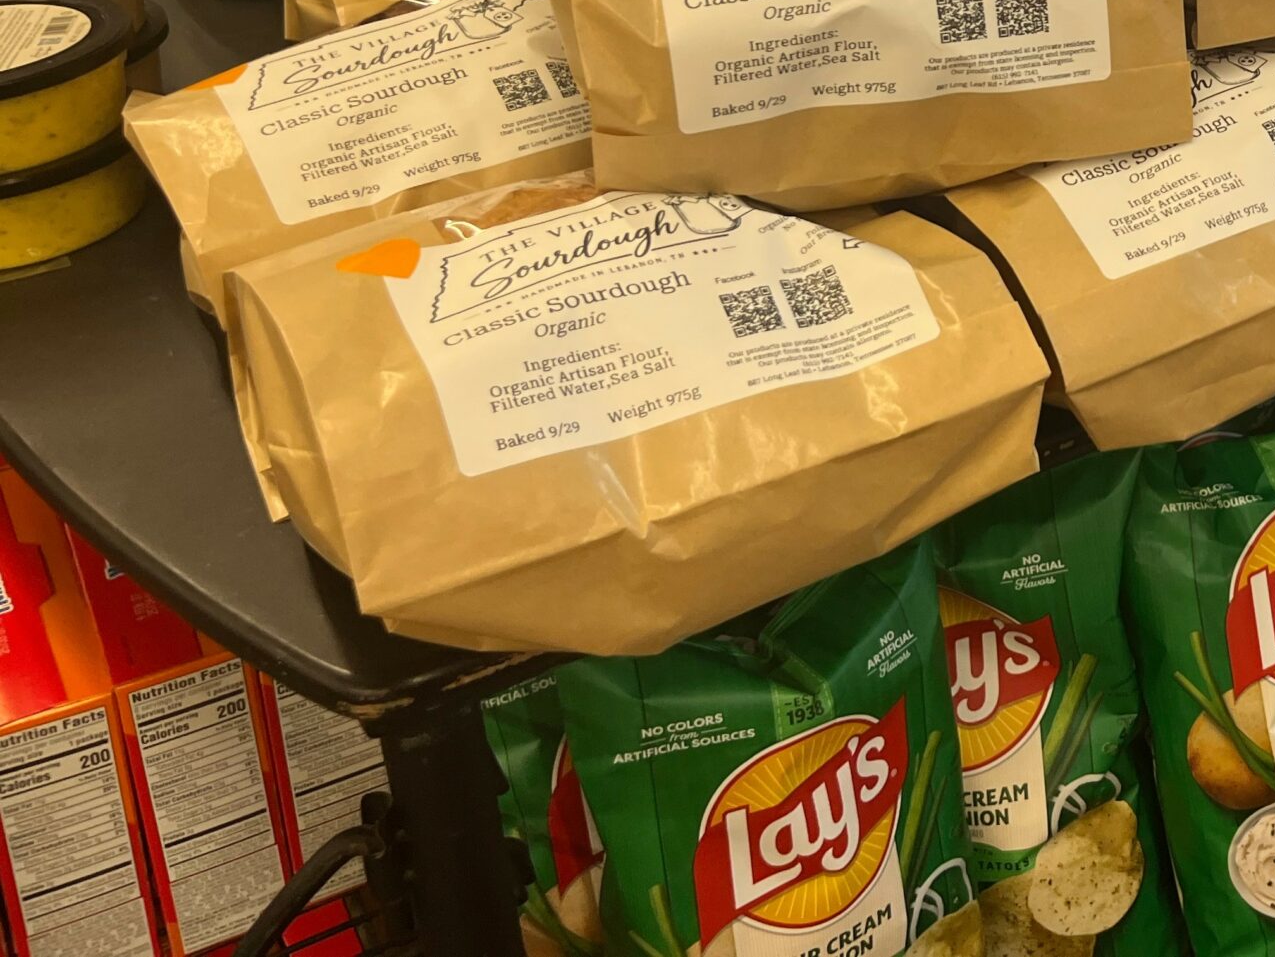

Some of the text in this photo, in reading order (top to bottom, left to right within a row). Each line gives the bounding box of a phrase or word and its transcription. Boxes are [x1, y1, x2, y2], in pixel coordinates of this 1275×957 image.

[764, 0, 831, 20] Organic
[715, 40, 877, 72] Organic Artisan Flour,
[749, 29, 839, 52] Ingredients:
[283, 24, 459, 95] Sourdough
[713, 68, 772, 85] Filtered
[852, 50, 880, 62] Salt
[260, 67, 468, 136] Classic Sourdough
[812, 81, 897, 96] Weight 975g
[712, 95, 786, 117] Baked 9/29
[403, 151, 482, 180] Weight 975g
[1061, 154, 1129, 188] Classic
[307, 184, 381, 208] Baked 9/29
[479, 200, 658, 264] THE VILLAGE
[1124, 201, 1268, 261] Baked 9/29 Weight 975g
[470, 210, 680, 300] Sourdough
[443, 271, 692, 346] Classic Sourdough
[534, 312, 607, 337] Organic
[489, 346, 669, 398] Organic Artisan Flour,
[523, 342, 622, 373] Ingredients:
[489, 390, 556, 413] Filtered
[644, 356, 676, 375] Salt
[496, 386, 702, 451] Baked 9/29 Weight 975g
[1002, 559, 1065, 580] ARTIFICIAL
[1023, 554, 1041, 565] NO
[1015, 575, 1056, 591] Flavors
[866, 630, 914, 670] ARTIFICIAL
[879, 630, 895, 645] NO
[879, 649, 911, 677] Flavors
[132, 661, 241, 703] Nutrition Facts
[217, 699, 246, 718] 200
[786, 702, 825, 726] 1938
[141, 723, 190, 745] Calories
[641, 713, 723, 739] NO COLORS
[669, 730, 699, 742] from
[613, 728, 756, 765] ARTIFICIAL SOURCES
[725, 735, 890, 911] Lay's
[827, 903, 892, 955] CREAM
